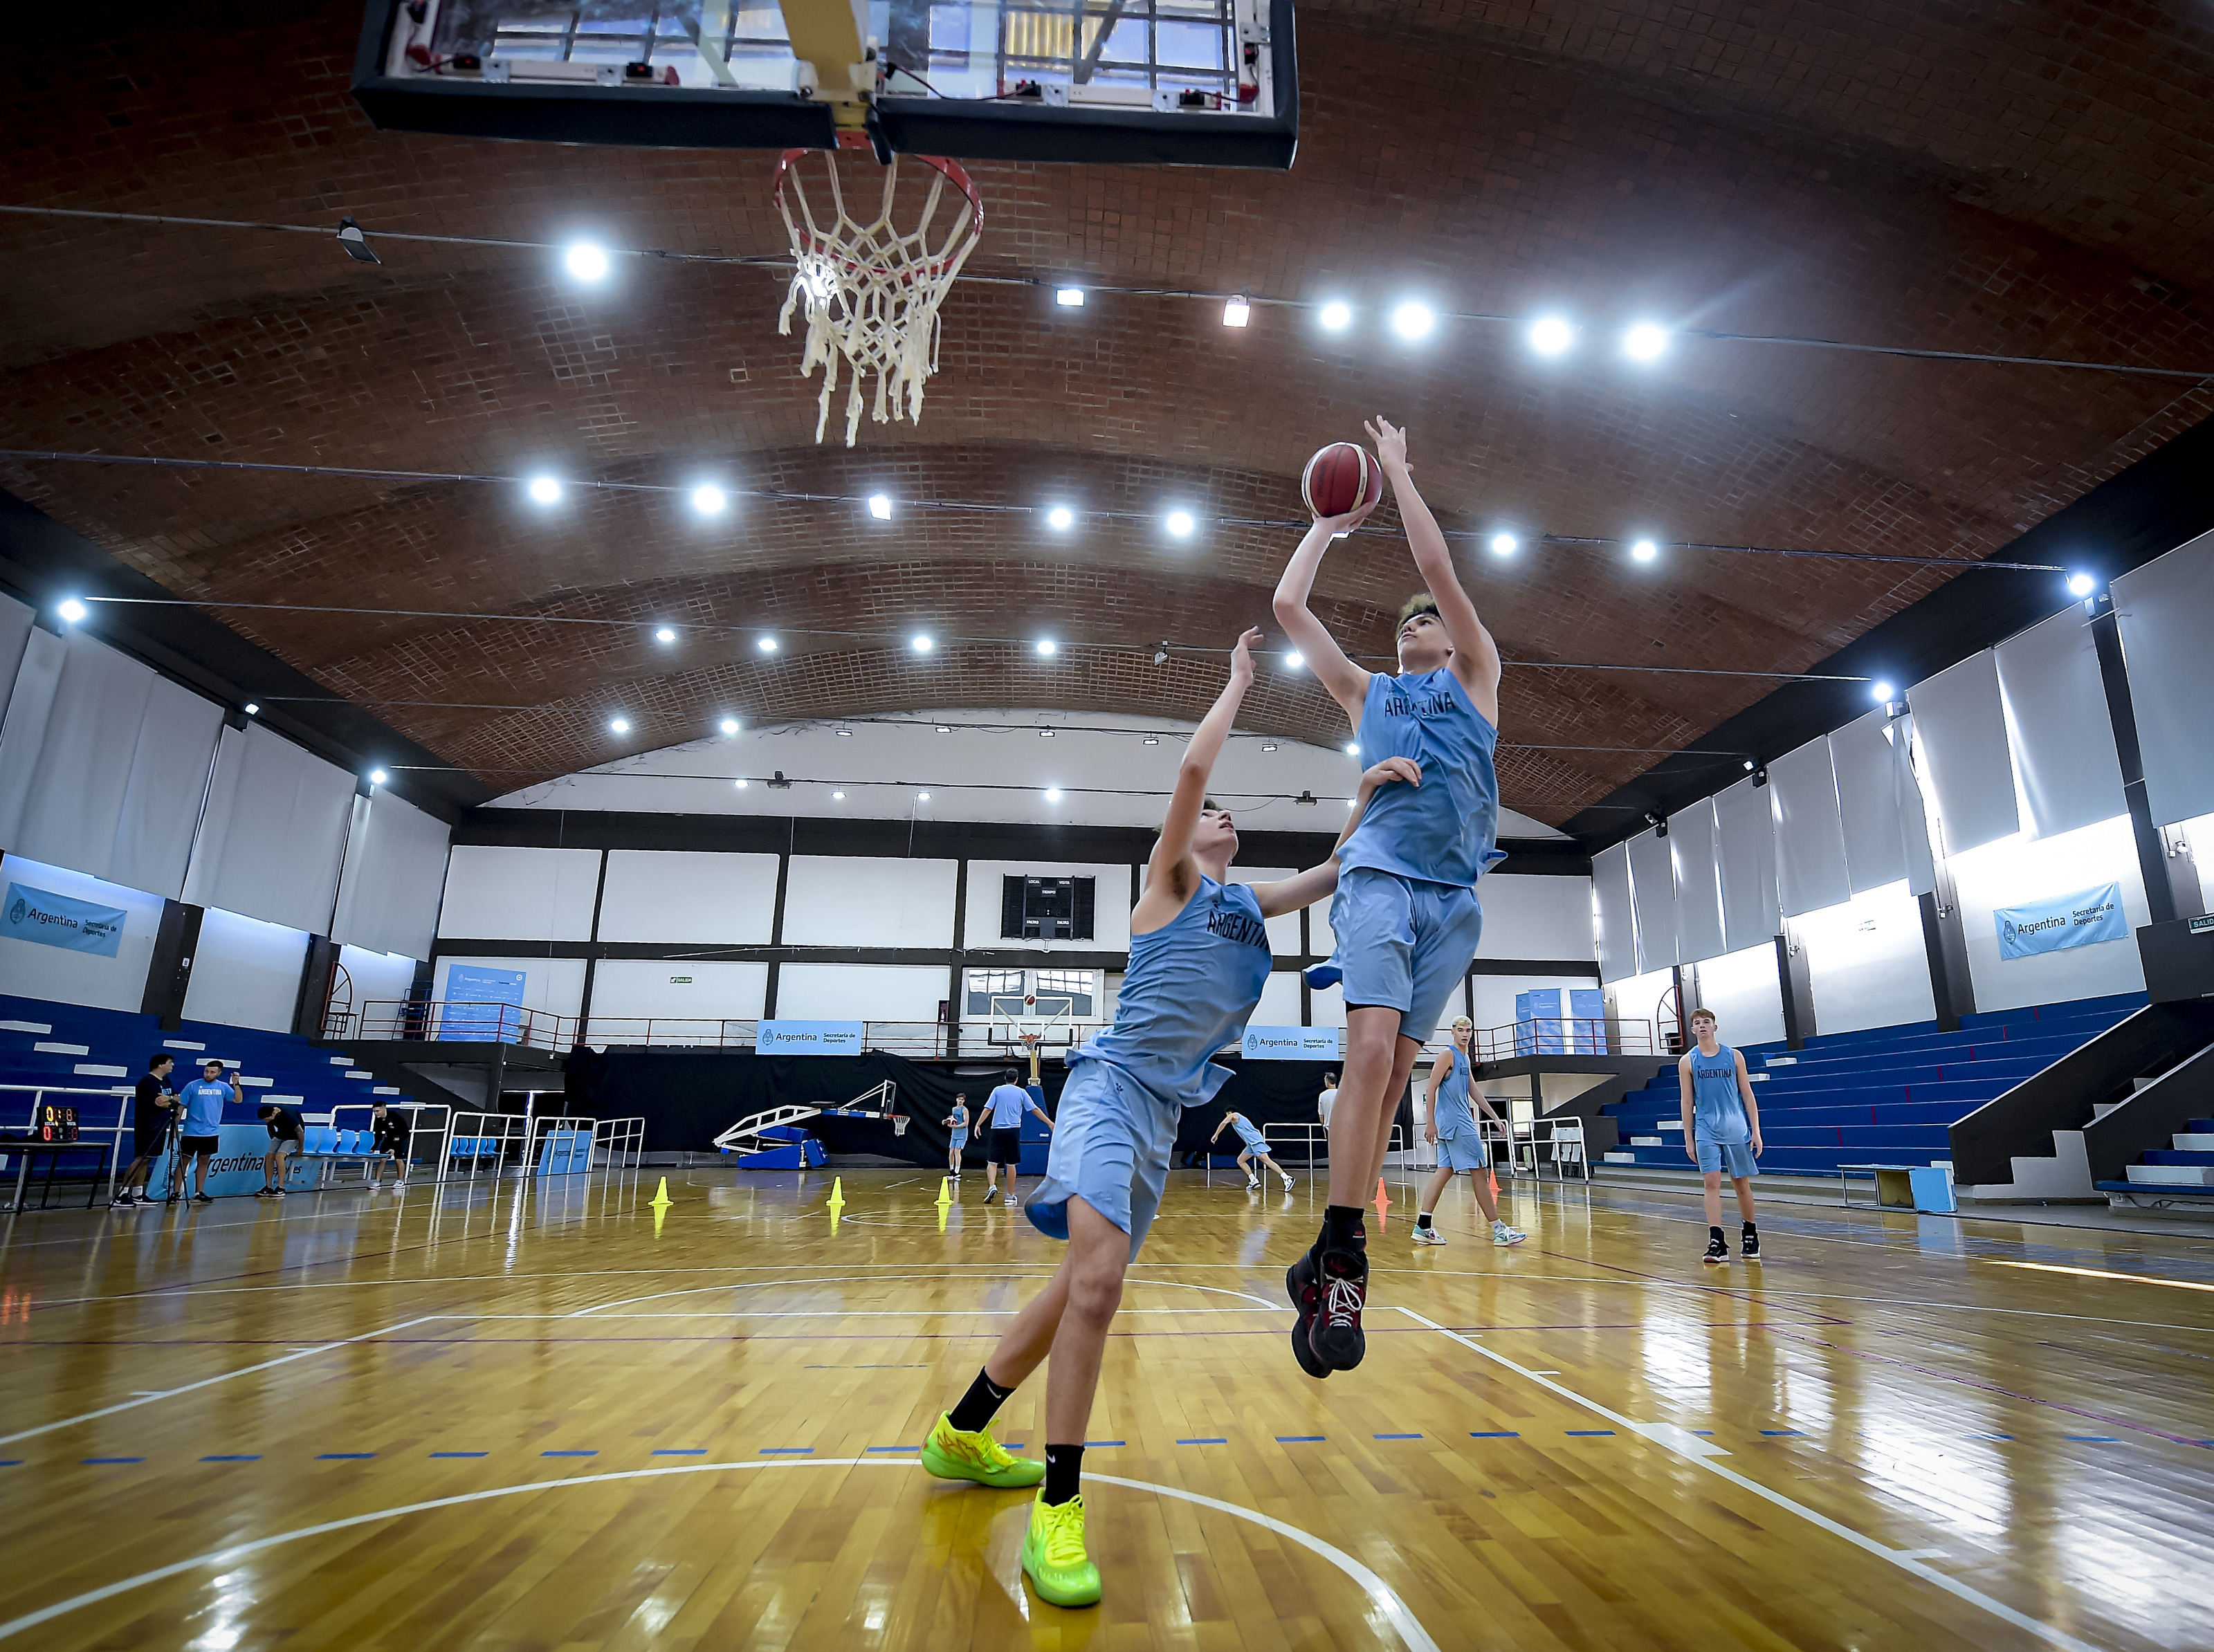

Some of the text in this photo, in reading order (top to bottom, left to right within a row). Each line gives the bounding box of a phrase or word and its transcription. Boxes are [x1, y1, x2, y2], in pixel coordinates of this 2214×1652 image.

[2072, 902, 2114, 918] Secretaría de
[27, 908, 78, 928] Argentina
[2074, 915, 2103, 926] Deportes
[2018, 917, 2066, 935] Argentina
[82, 927, 106, 938] Deportes
[776, 1033, 817, 1043] Argentina
[1259, 1038, 1298, 1047] Argentina
[1697, 1069, 1732, 1079] ARGENTINA
[208, 1153, 265, 1177] rgentina
